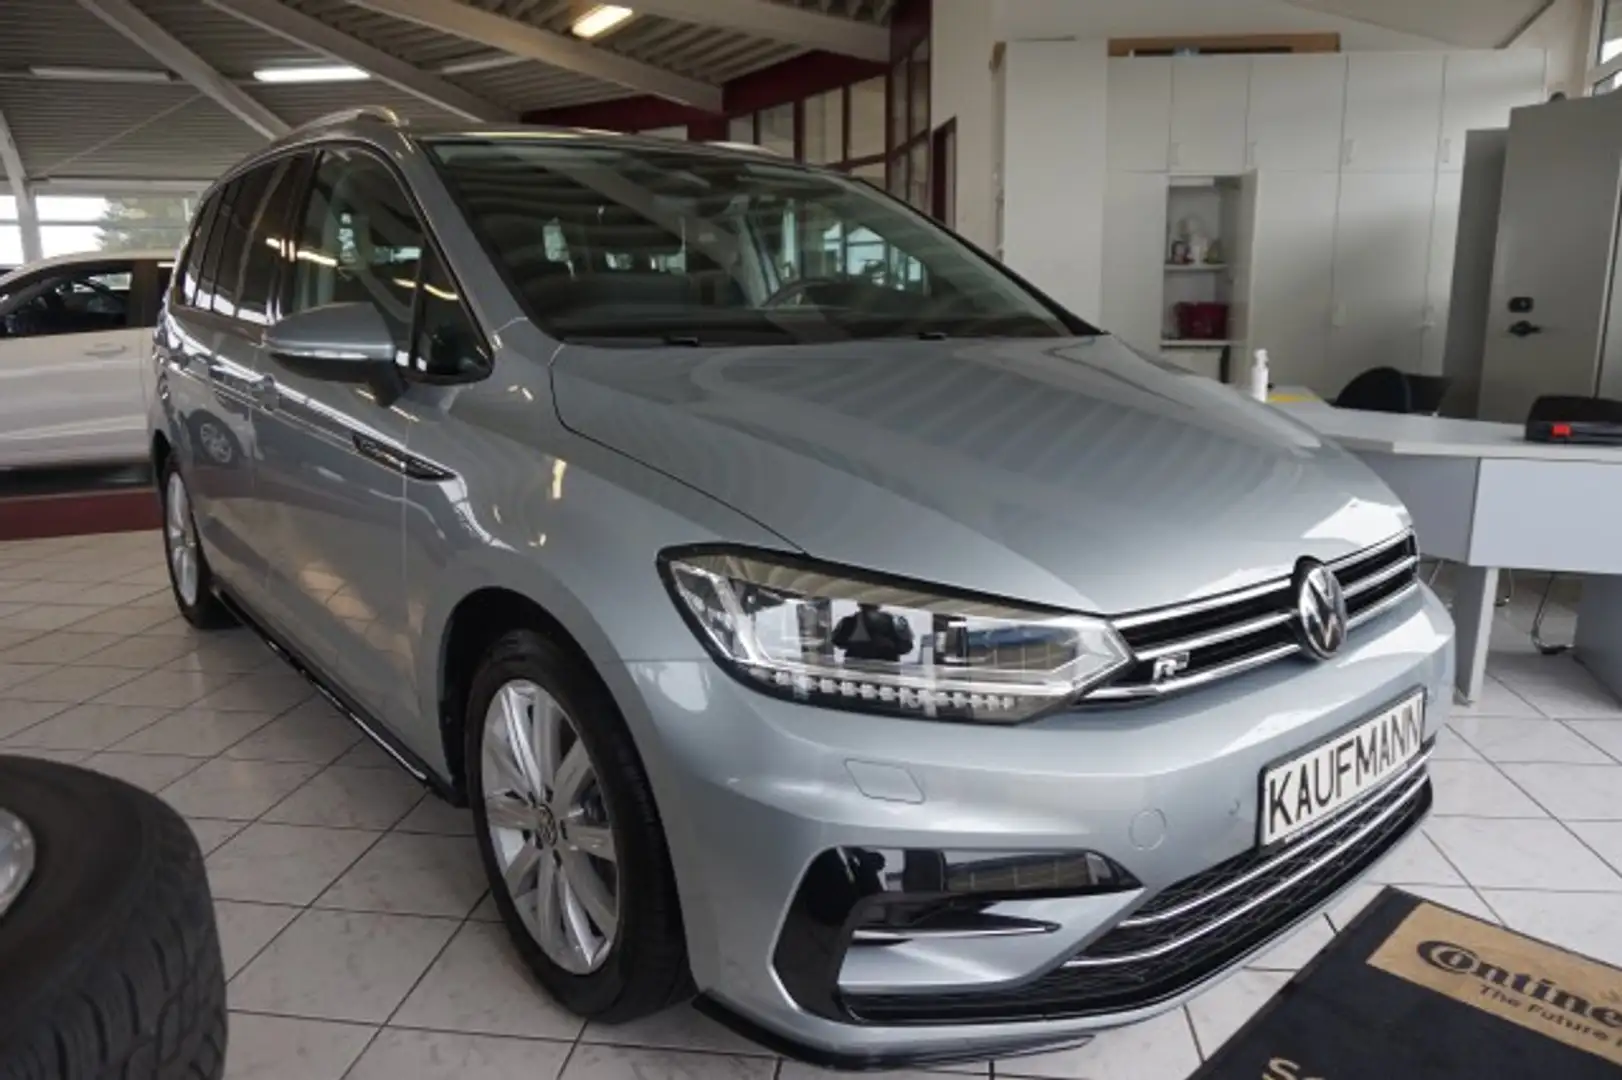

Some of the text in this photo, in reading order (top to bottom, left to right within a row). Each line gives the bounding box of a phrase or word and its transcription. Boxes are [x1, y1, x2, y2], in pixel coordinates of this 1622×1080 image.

[1267, 702, 1422, 834] KAUFMANN
[1480, 983, 1521, 1008] The
[1527, 1003, 1609, 1041] Future
